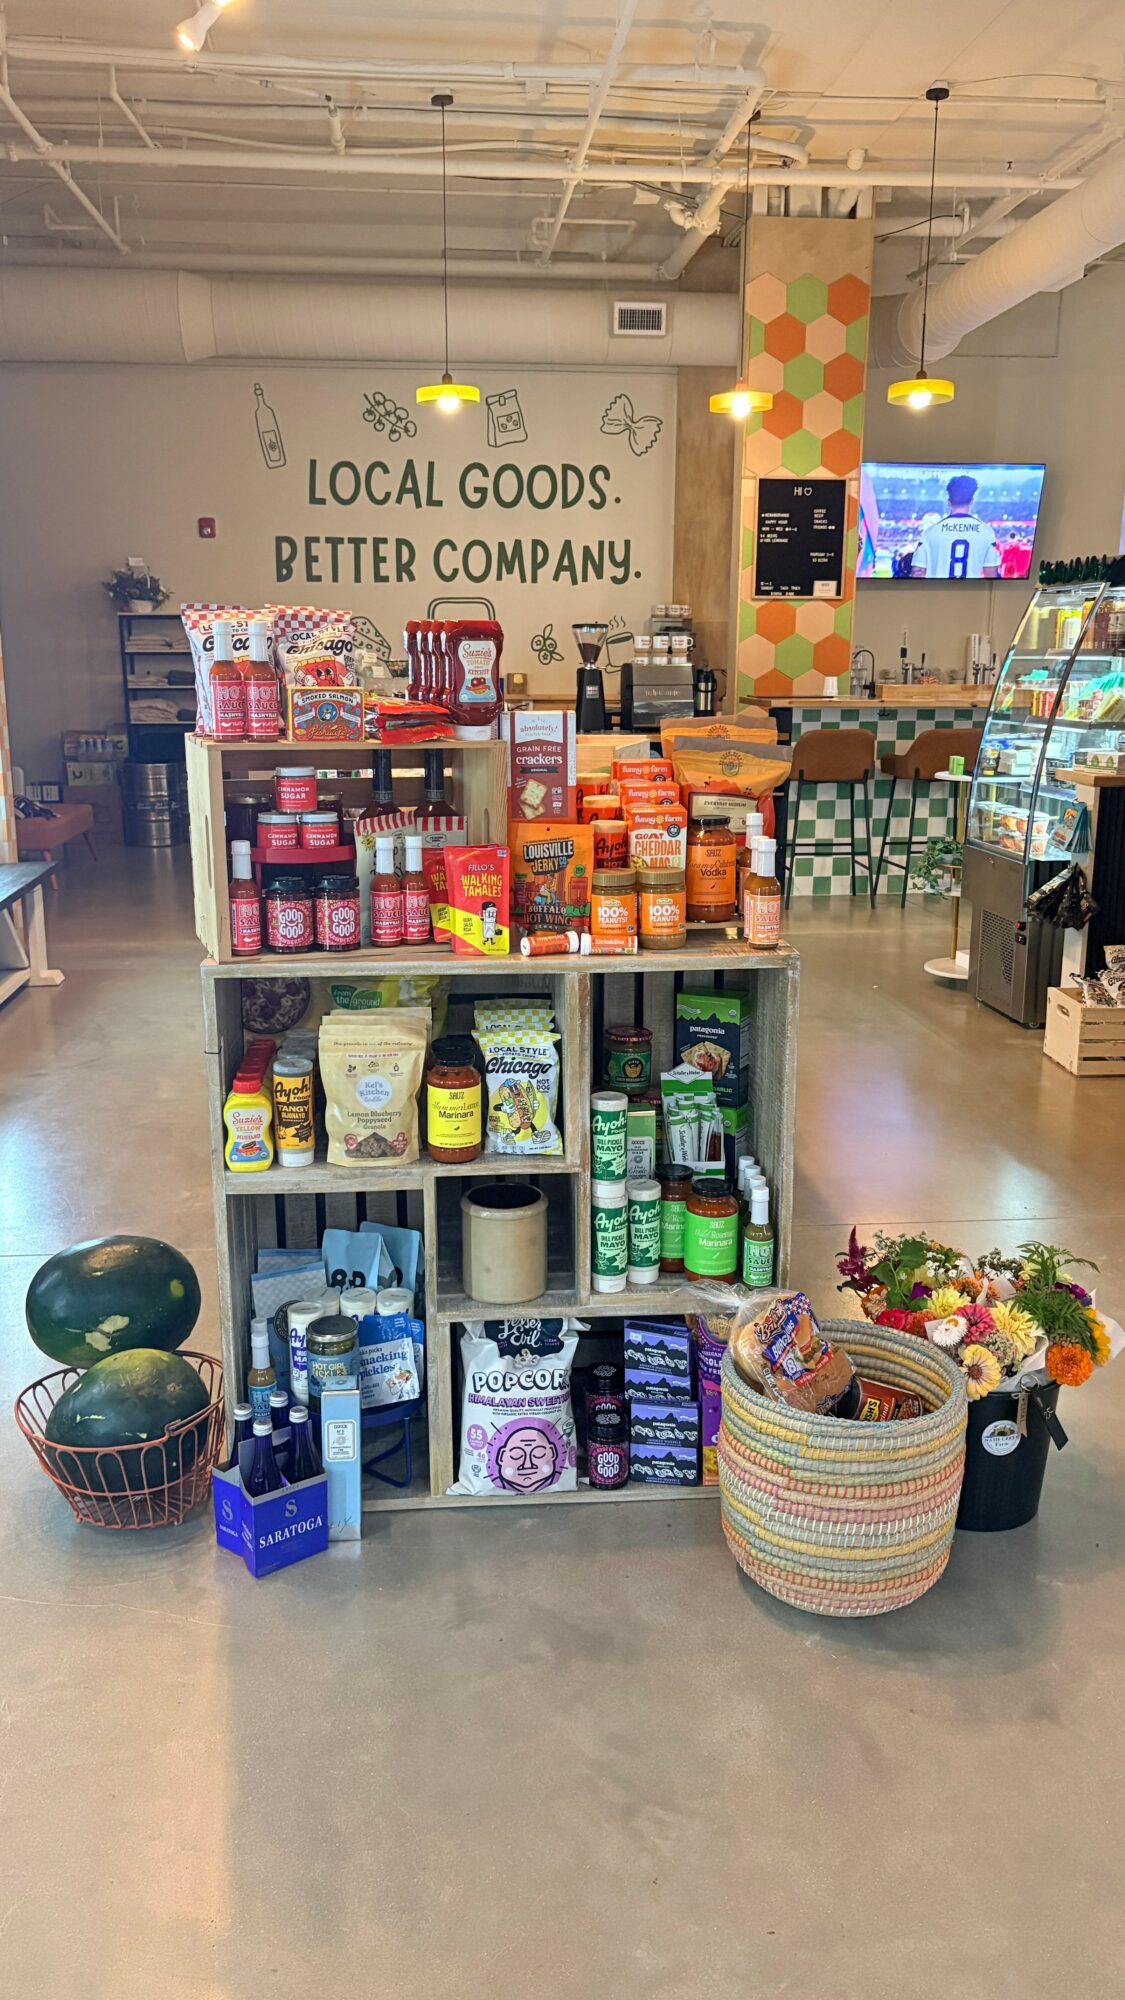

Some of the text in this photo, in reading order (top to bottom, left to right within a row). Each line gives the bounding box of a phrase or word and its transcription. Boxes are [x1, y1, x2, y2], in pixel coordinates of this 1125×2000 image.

[309, 459, 622, 510] LOCAL GOODS.
[794, 487, 802, 496] HI
[942, 522, 980, 533] McKENNIE
[275, 536, 642, 586] BETTER COMPANY.
[950, 539, 970, 578] 8
[287, 638, 352, 656] Chicago
[463, 643, 492, 658] Suzie's
[302, 694, 354, 703] SMOKED SALMON
[516, 754, 562, 764] crackers
[622, 766, 642, 774] funny
[628, 789, 649, 798] funny
[635, 815, 656, 824] funny
[524, 840, 573, 859] LOUISVILLE
[635, 840, 681, 856] CHEDDAR
[533, 856, 567, 872] JERKY CO
[650, 857, 670, 867] MAC
[700, 867, 727, 877] Vodka
[461, 873, 502, 886] WALKING
[463, 884, 502, 897] TAMALES
[332, 907, 355, 921] GOOD
[528, 905, 566, 914] BUFFALO
[597, 907, 628, 917] 100%
[649, 905, 679, 916] 100%
[280, 909, 303, 922] GOOD
[545, 914, 572, 926] WING
[280, 924, 304, 938] GOOD
[332, 923, 355, 937] GOOD
[334, 989, 352, 998] from
[336, 996, 380, 1007] the ground
[690, 1026, 725, 1035] patagonia
[520, 1047, 547, 1056] STYLE
[485, 1056, 552, 1079] Chicago
[274, 1078, 310, 1101] Ayoh!
[359, 1088, 390, 1096] Kitchen
[449, 1091, 464, 1100] SAUZ
[233, 1112, 263, 1124] Suzie's
[370, 1110, 402, 1118] Blueberry
[438, 1110, 474, 1119] Marinara
[357, 1116, 392, 1124] Poppyseed
[592, 1111, 627, 1135] Ayoh!
[634, 1232, 658, 1240] MAYO
[600, 1240, 626, 1248] MAYO
[510, 1326, 541, 1347] Evil
[312, 1362, 327, 1370] HOT
[787, 1359, 796, 1374] 8
[468, 1393, 526, 1407] HIMALAYAN
[470, 1428, 483, 1439] 55
[598, 1452, 619, 1464] GOOD
[598, 1464, 619, 1477] GOOD
[259, 1516, 323, 1549] SARATOGA
